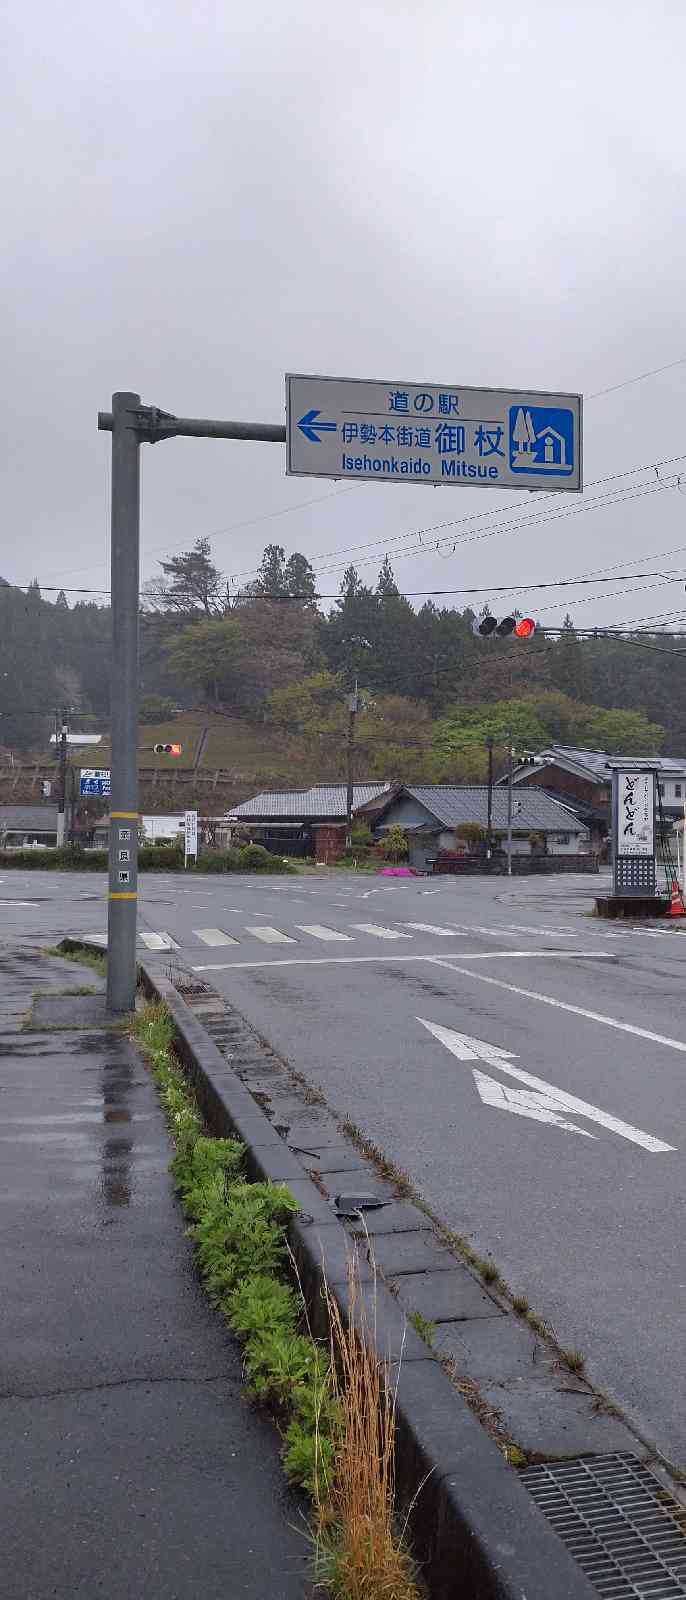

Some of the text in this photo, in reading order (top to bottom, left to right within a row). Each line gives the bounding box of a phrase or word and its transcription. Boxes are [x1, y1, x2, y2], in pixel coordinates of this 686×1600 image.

[389, 391, 459, 415] 道の駅
[341, 422, 506, 457] 伊勢本街道 御杖
[342, 454, 499, 479] Isehonkaido Mitsue
[624, 776, 640, 836] どんどん
